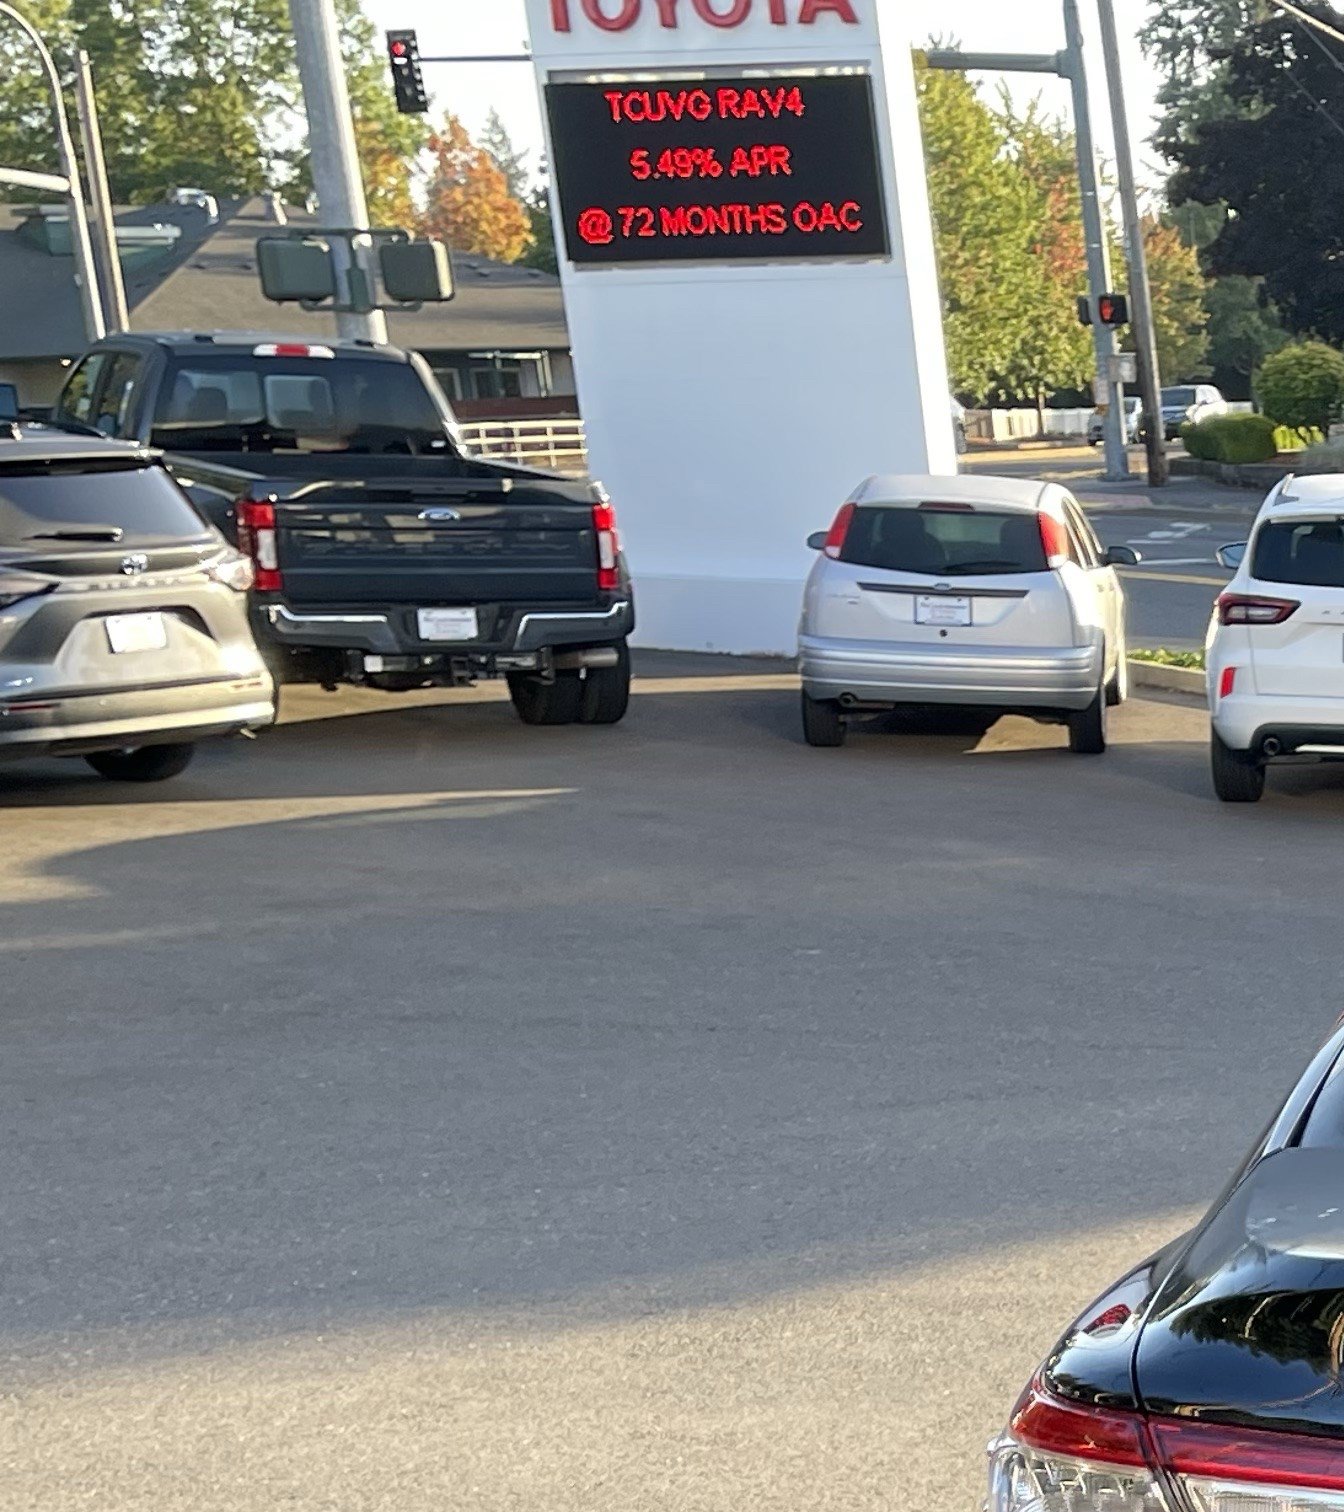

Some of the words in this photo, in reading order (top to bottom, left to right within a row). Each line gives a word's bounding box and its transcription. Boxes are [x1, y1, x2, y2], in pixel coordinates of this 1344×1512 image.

[605, 88, 711, 123] TCUVG
[716, 86, 805, 119] RAV4
[629, 148, 723, 181] 5.49%
[730, 145, 793, 177] APR
[577, 207, 615, 244] @
[617, 206, 656, 237] 72
[660, 204, 786, 236] MONTHS
[793, 202, 863, 232] OAC
